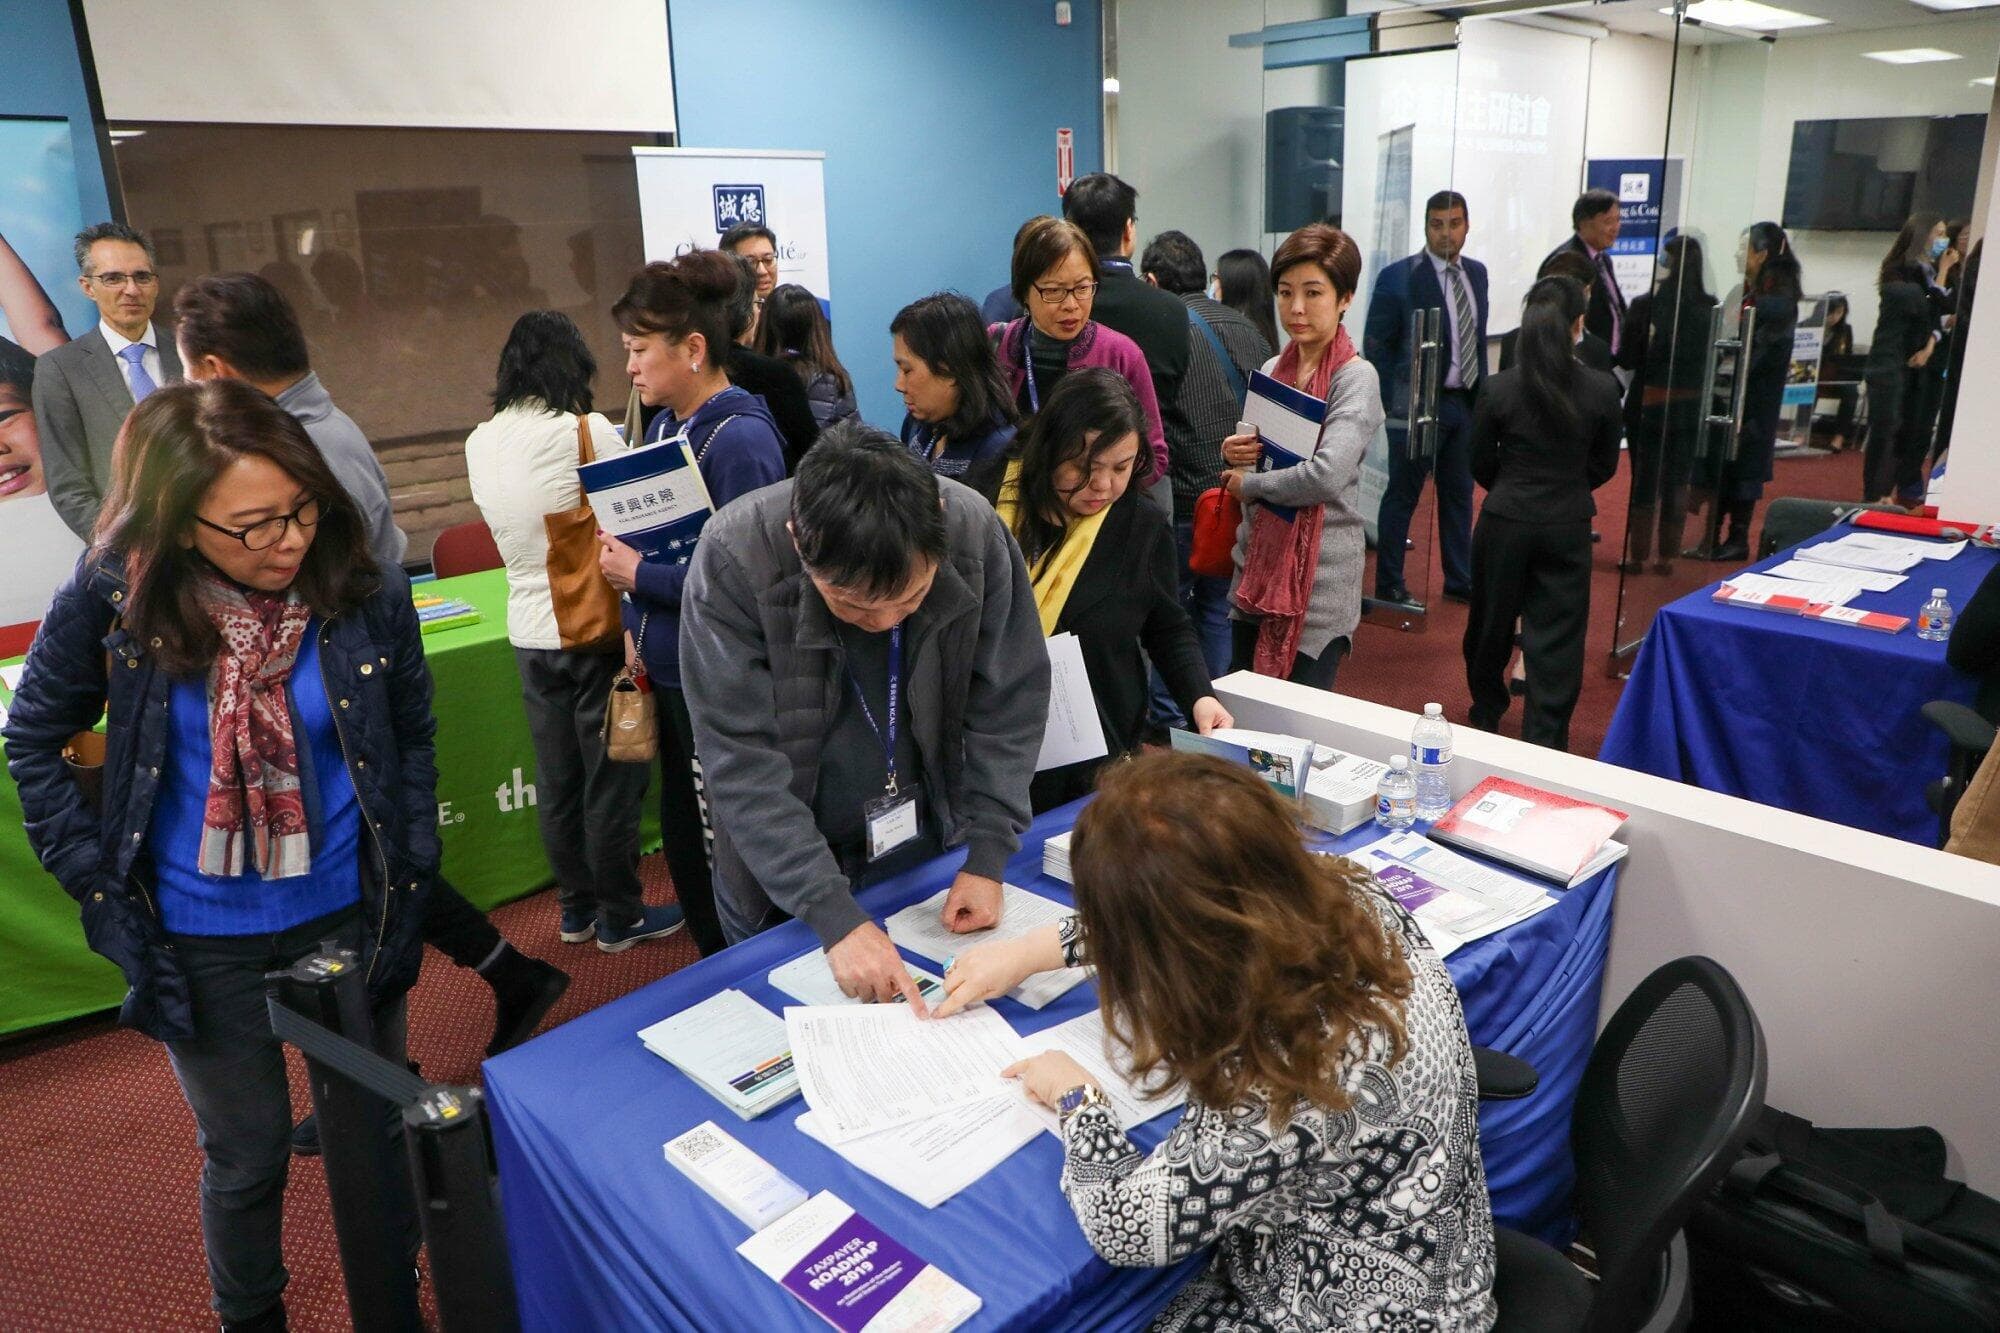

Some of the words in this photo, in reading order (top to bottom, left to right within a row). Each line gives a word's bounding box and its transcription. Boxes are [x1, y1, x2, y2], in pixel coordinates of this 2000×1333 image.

[719, 192, 761, 222] 誠德
[611, 488, 676, 515] 華興保險
[804, 1237, 865, 1276] TAXPAYER
[809, 1241, 878, 1291] ROADMAP
[839, 1261, 873, 1287] 2019
